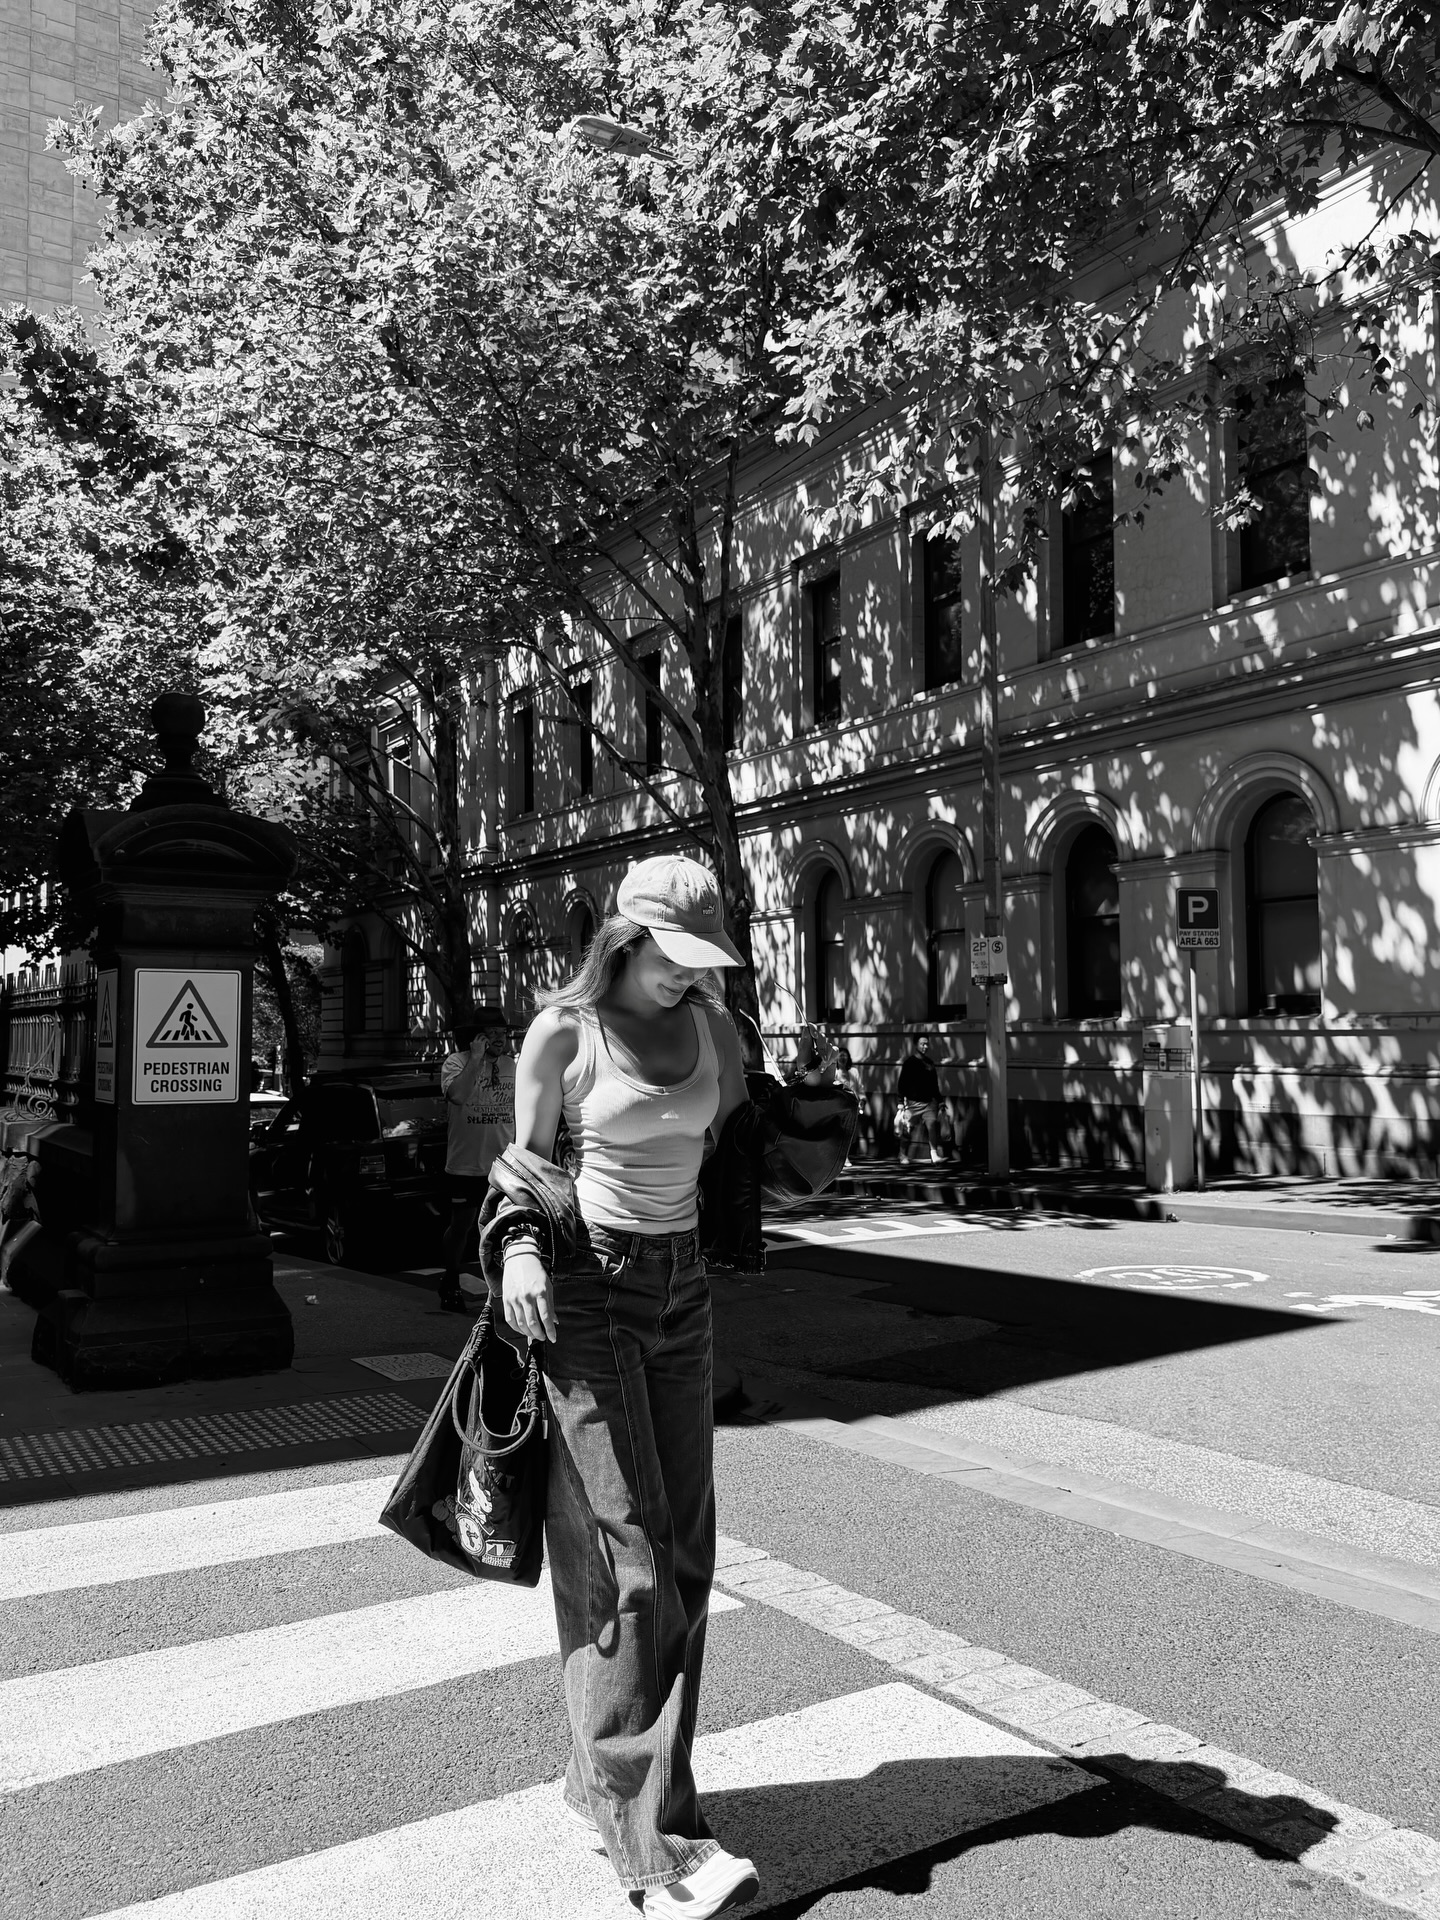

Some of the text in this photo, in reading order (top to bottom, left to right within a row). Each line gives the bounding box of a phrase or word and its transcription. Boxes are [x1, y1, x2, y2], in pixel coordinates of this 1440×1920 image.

[1187, 895, 1209, 923] P
[972, 942, 987, 952] 2P
[1180, 937, 1219, 946] AREA 663
[143, 1061, 230, 1076] PEDESTRIAN
[150, 1078, 223, 1093] CROSSING
[466, 1116, 500, 1125] SILENT
